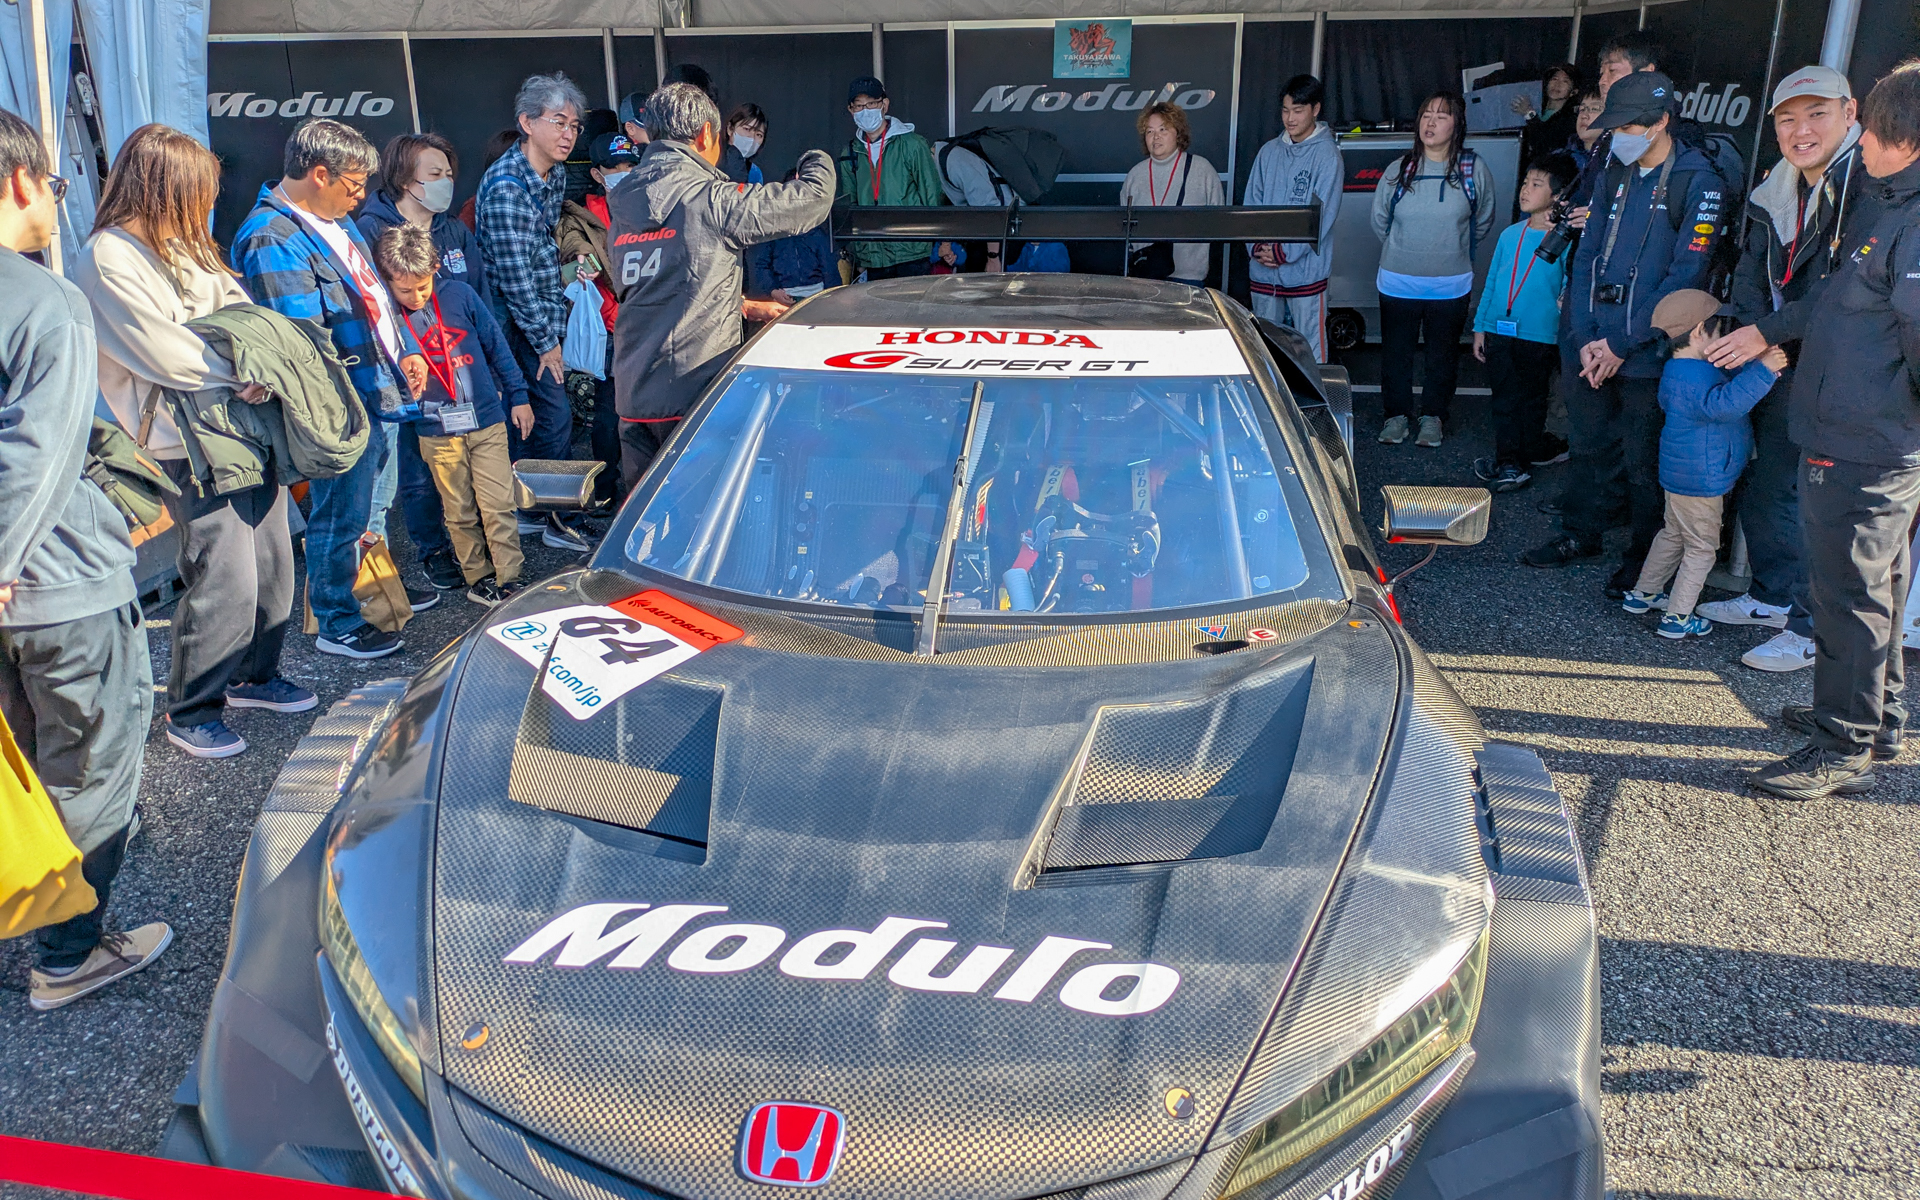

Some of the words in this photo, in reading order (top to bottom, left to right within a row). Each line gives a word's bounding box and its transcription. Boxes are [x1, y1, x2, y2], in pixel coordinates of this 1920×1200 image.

[207, 91, 394, 118] Modulo
[971, 82, 1216, 113] Modulo
[1703, 191, 1720, 199] VISA
[1696, 213, 1718, 221] ROKT
[614, 227, 676, 247] Modulo
[622, 248, 662, 285] 64
[876, 331, 1103, 349] HONDA
[904, 358, 1072, 371] SUPER
[1078, 360, 1149, 371] GT
[643, 607, 723, 641] AUTOBACS
[559, 615, 679, 665] 64
[532, 642, 601, 707] zfcom/jp
[502, 902, 1181, 1016] Modulo
